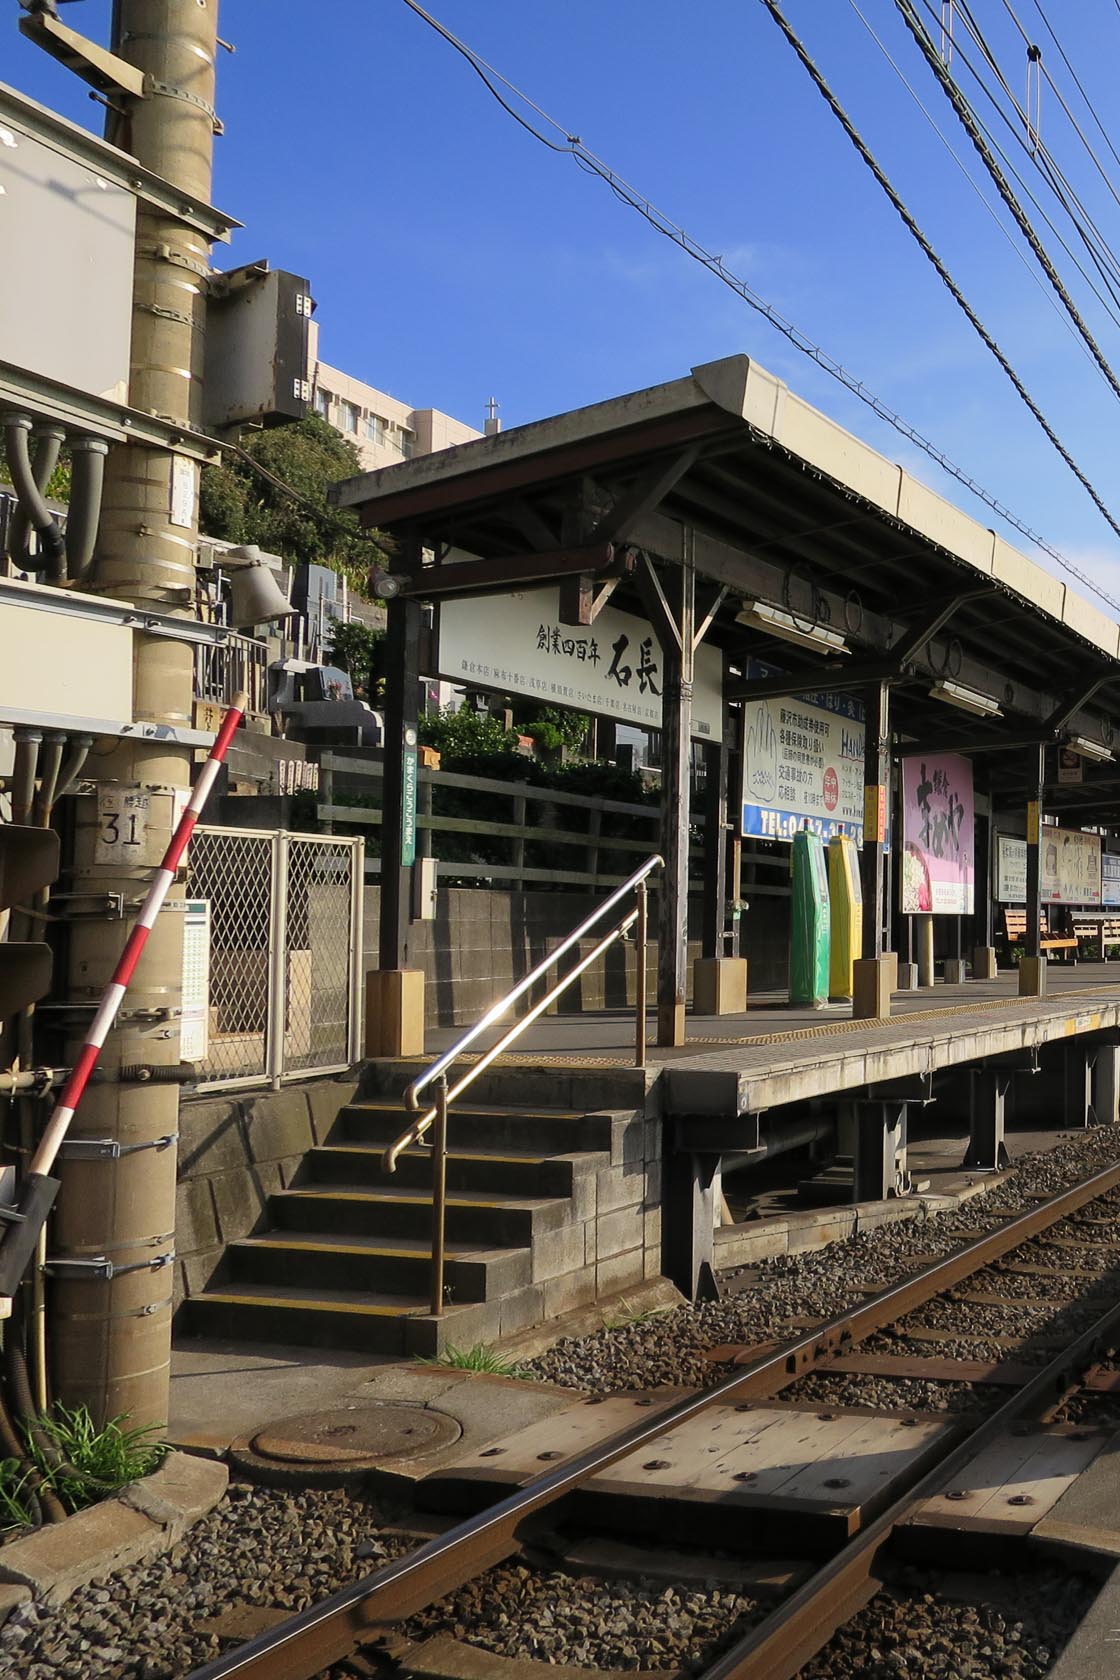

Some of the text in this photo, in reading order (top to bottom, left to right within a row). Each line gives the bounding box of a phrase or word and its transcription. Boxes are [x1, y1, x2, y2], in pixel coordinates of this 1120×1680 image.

[536, 624, 663, 696] 創業四百年 石長
[778, 764, 813, 786] 交通事故の方
[405, 756, 415, 845] かまくらこうこうまえ
[778, 784, 796, 801] 応相談
[102, 813, 141, 845] 31
